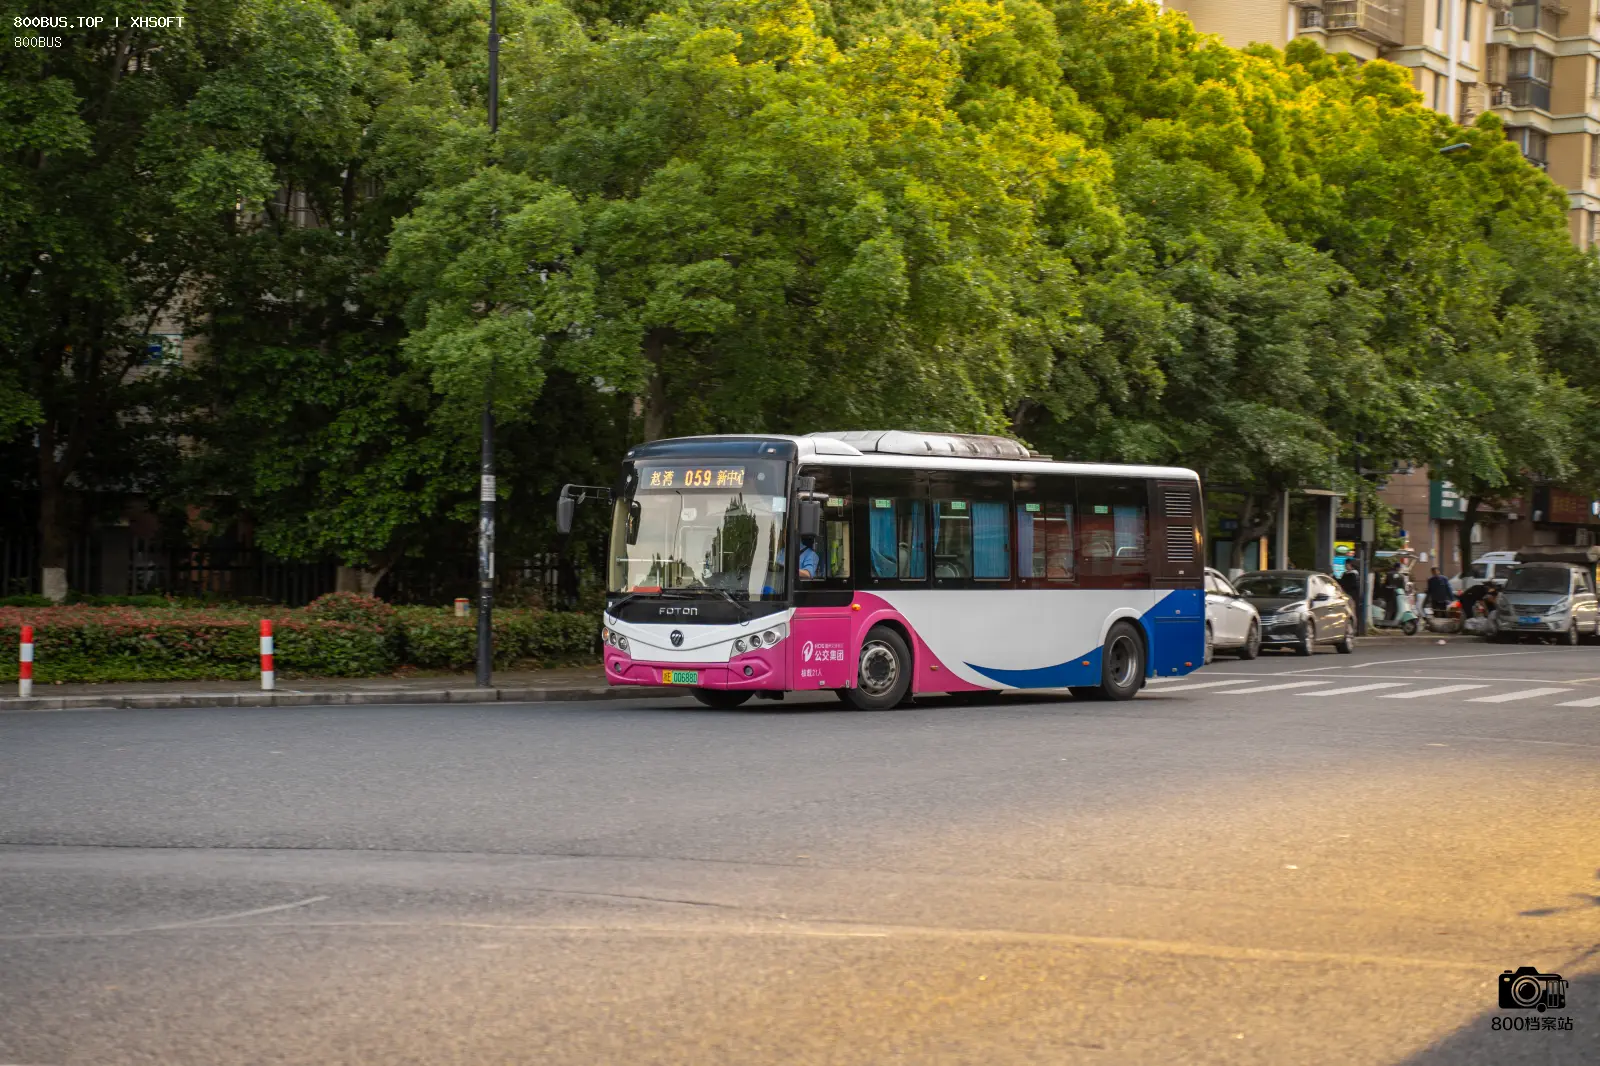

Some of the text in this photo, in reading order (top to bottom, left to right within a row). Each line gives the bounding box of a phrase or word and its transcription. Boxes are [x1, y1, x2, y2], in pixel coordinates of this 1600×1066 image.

[684, 469, 712, 487] 059
[716, 469, 745, 487] 新中心
[659, 607, 698, 615] FOTON
[814, 649, 844, 662] 公交集团
